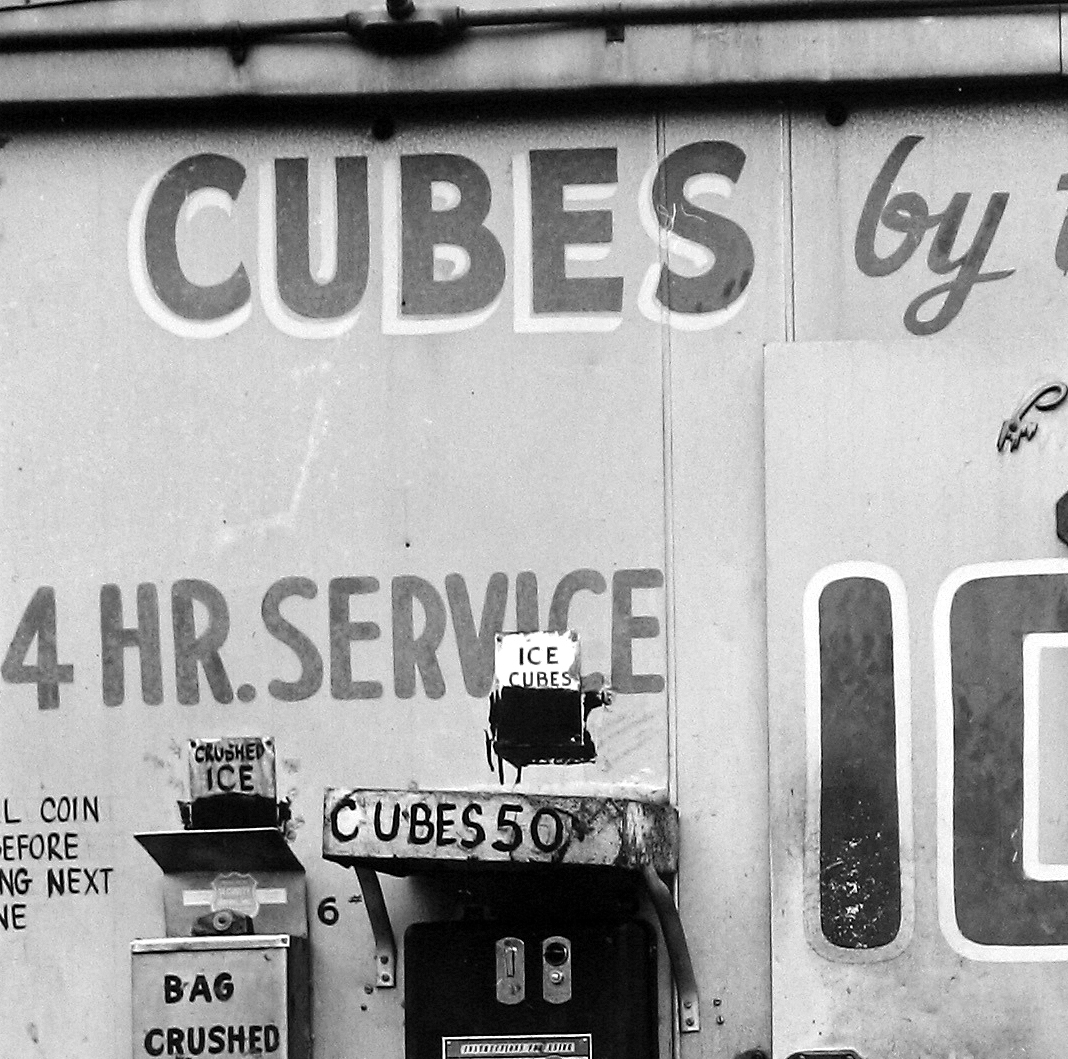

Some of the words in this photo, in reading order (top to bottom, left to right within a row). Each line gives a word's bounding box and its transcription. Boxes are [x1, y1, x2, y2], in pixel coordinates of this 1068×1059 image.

[128, 140, 755, 337] CUBES
[854, 135, 1015, 335] by
[519, 646, 559, 666] ICE
[509, 671, 572, 688] CUBES
[195, 742, 265, 763] CRUSHED
[206, 764, 255, 791] ICE
[40, 796, 100, 823] COIN
[331, 796, 486, 850] CUBES
[0, 833, 79, 861] EFORE
[47, 868, 114, 898] NEXT
[163, 972, 235, 1004] BAG
[144, 1024, 281, 1057] CRUSHED
